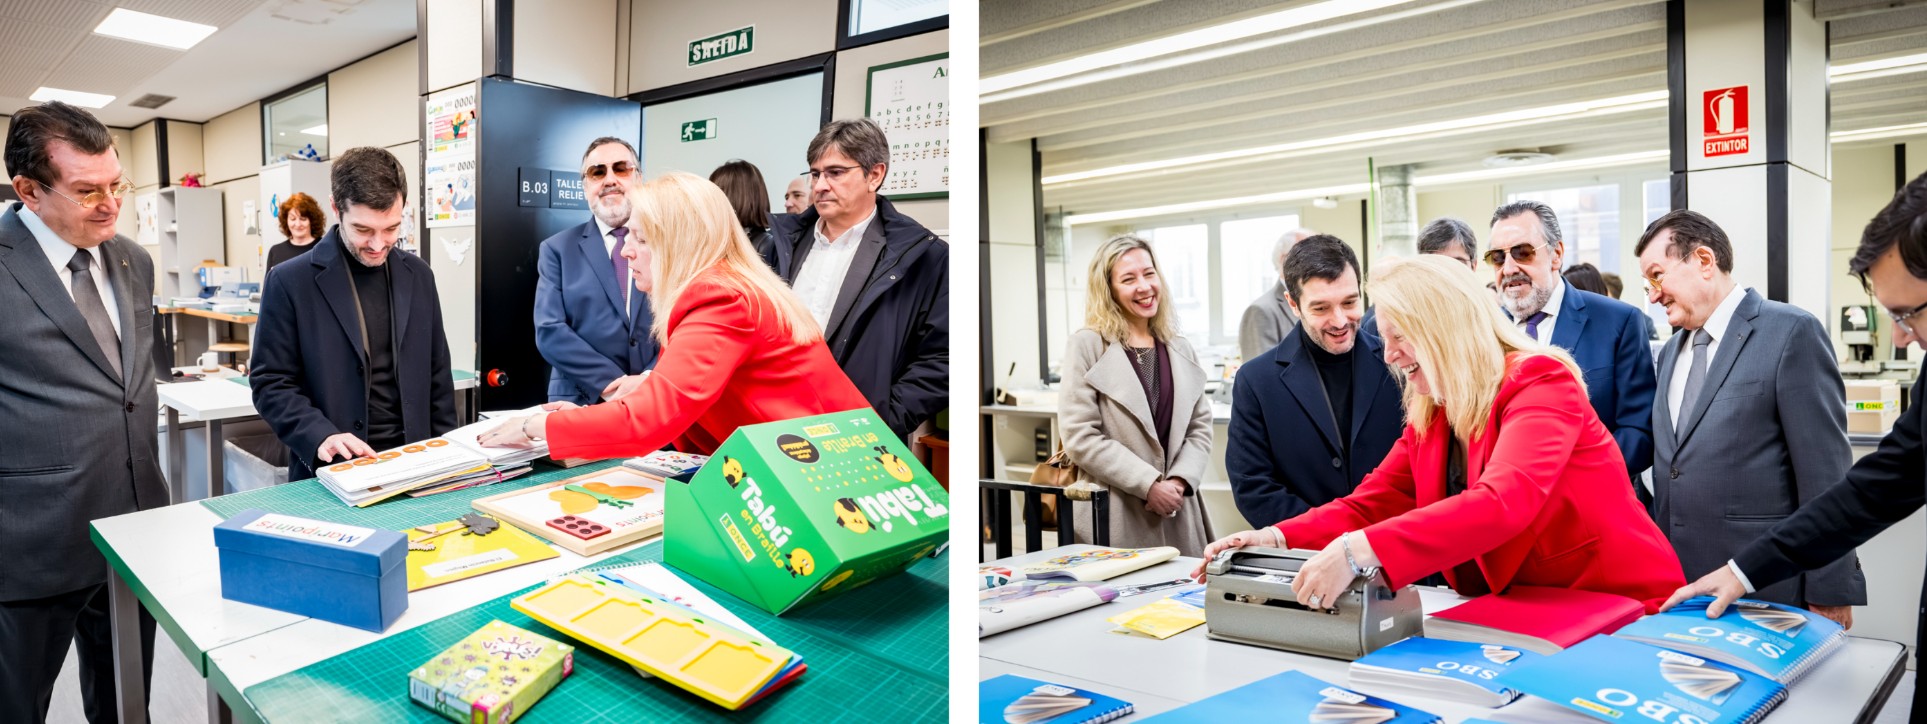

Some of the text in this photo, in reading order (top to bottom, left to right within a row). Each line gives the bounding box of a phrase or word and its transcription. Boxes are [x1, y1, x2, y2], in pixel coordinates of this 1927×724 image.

[692, 32, 748, 62] SALIDA
[937, 102, 943, 110] g
[1705, 138, 1748, 154] EXTINTOR
[522, 180, 548, 194] B.03
[556, 178, 583, 189] TALLE
[558, 190, 585, 200] RELIE
[820, 434, 867, 455] Braille
[861, 432, 879, 444] en
[741, 476, 793, 548] Tabú
[857, 483, 949, 533] Tabú
[256, 520, 361, 543] Maripoints
[741, 509, 784, 569] en Braille
[1688, 626, 1787, 659] SBO
[1436, 661, 1499, 680] SBO
